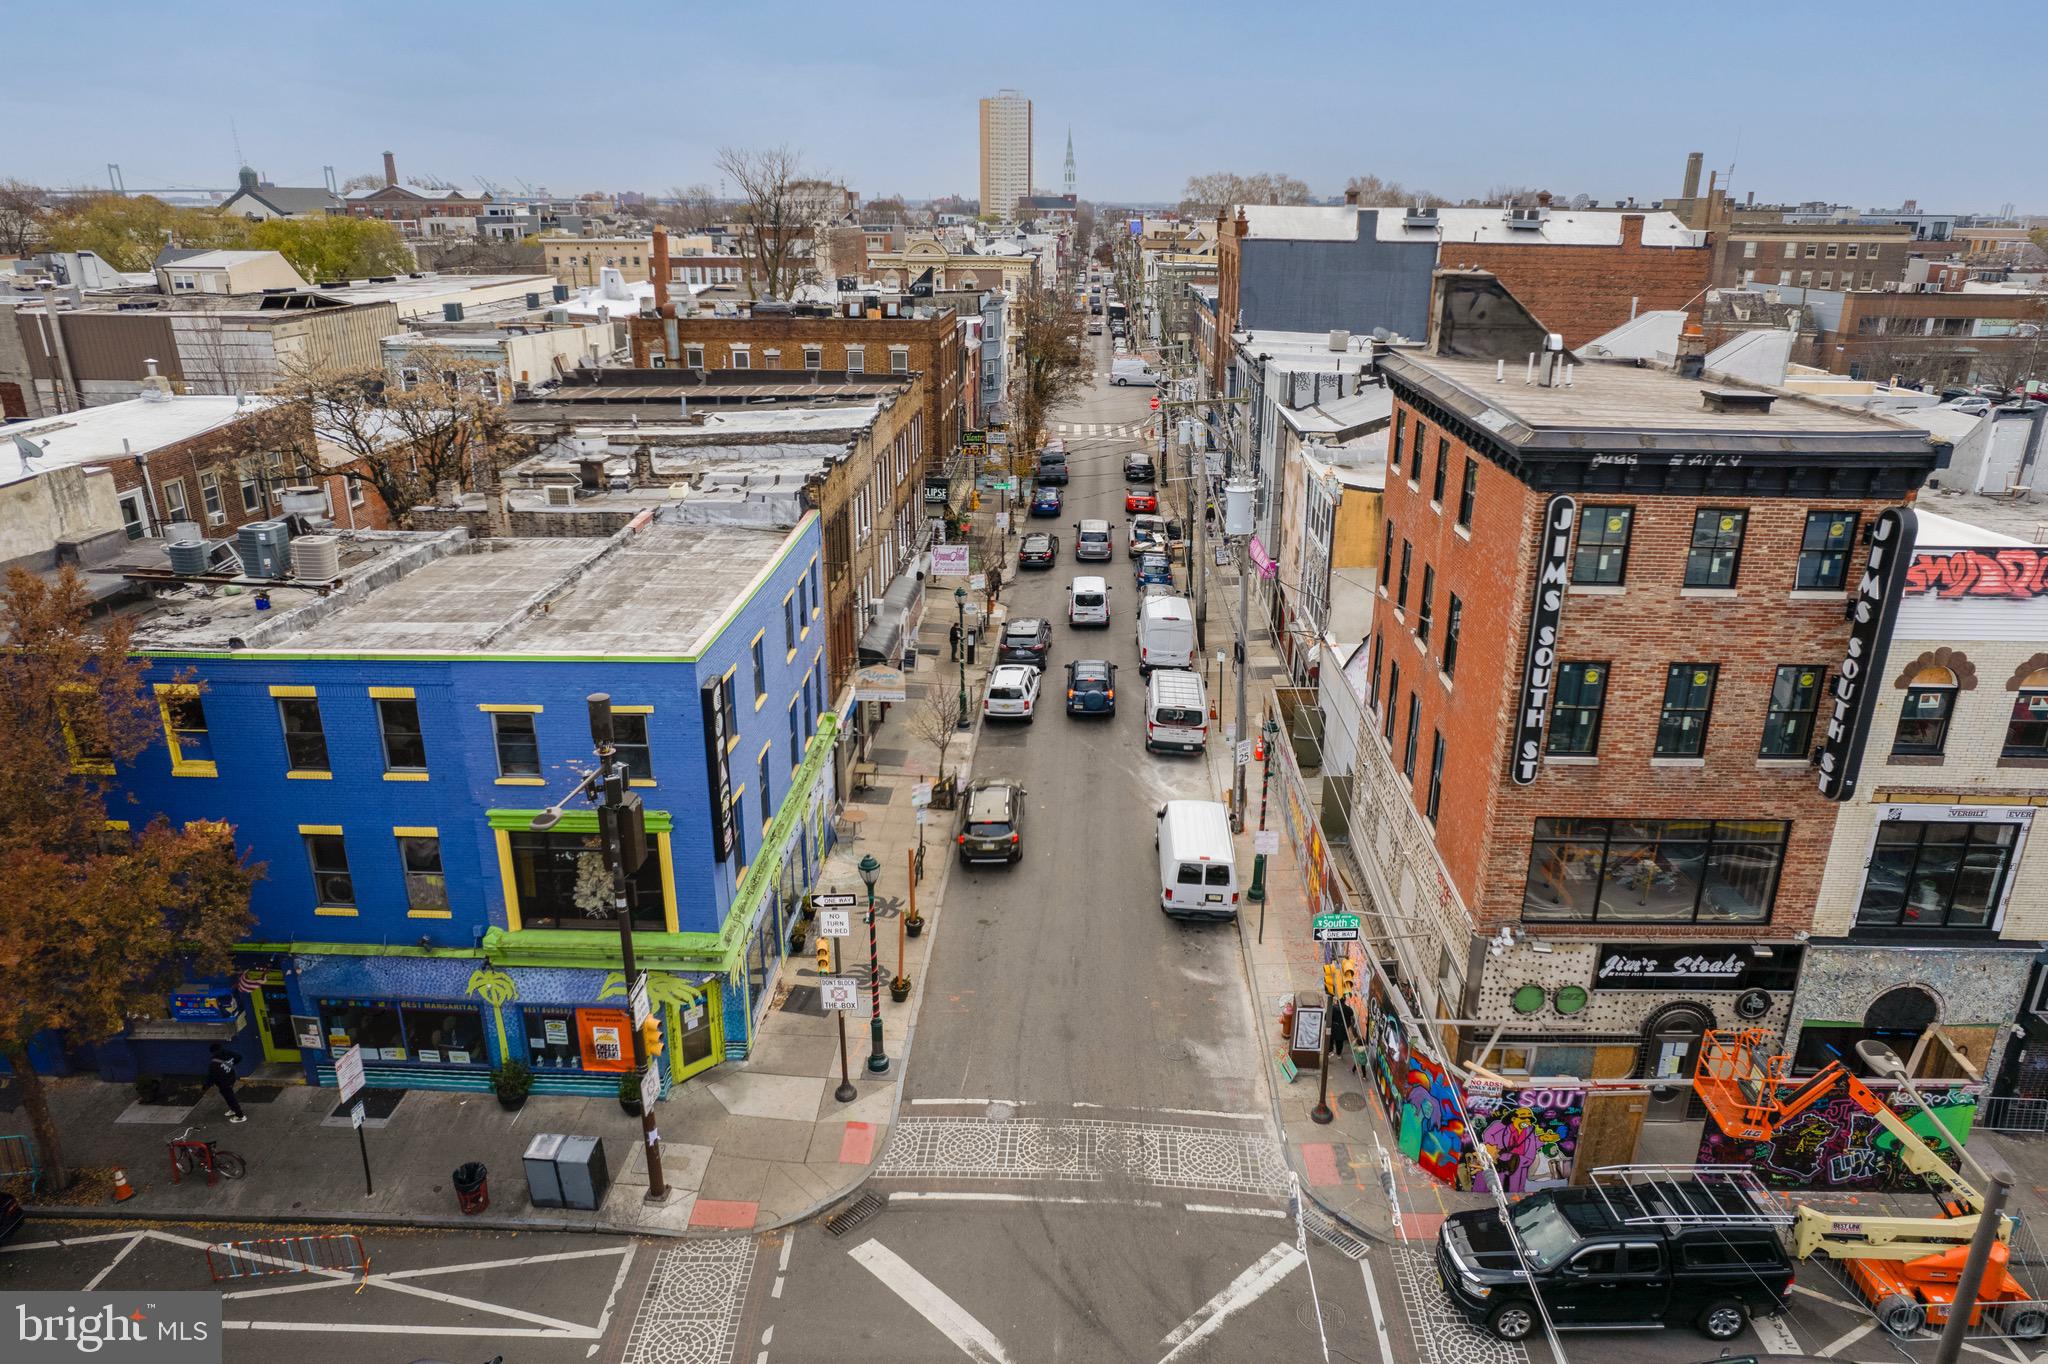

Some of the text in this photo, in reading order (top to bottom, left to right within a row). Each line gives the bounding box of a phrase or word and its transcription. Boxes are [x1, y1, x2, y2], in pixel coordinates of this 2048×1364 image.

[1542, 508, 1573, 612] JIMS
[1857, 518, 1894, 625] JIMS
[1525, 626, 1556, 728] SOUTH
[1828, 637, 1863, 744] SOUTH
[1239, 753, 1249, 762] 25
[1520, 741, 1539, 779] ST
[1818, 752, 1837, 794] ST
[1323, 919, 1359, 928] South St
[1600, 953, 1746, 979] Jim's Steaks
[596, 1043, 618, 1052] CHEESE
